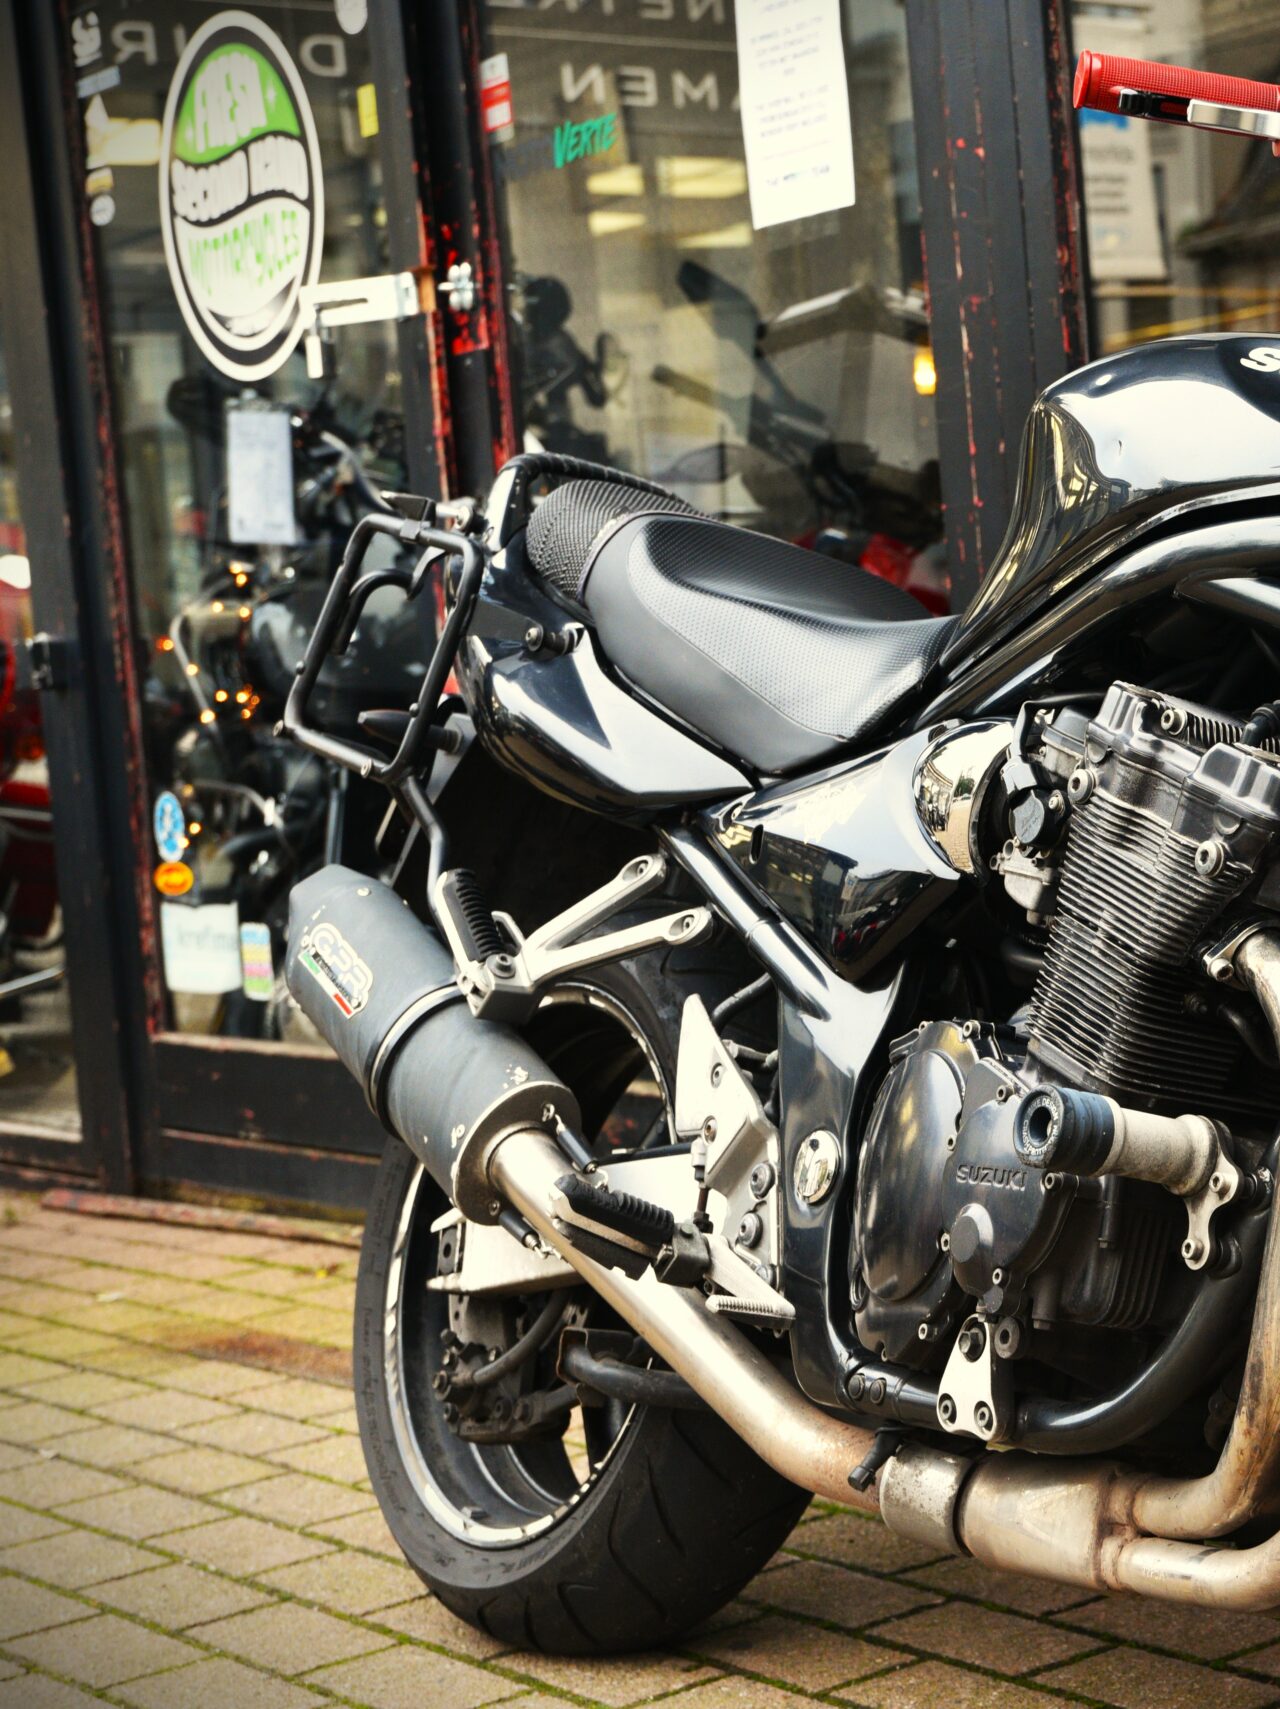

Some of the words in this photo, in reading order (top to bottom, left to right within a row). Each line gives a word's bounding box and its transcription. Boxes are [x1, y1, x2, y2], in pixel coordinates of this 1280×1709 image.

[553, 113, 618, 169] VERTE
[312, 929, 369, 1000] GPR
[955, 1164, 1027, 1192] SUZUKI
